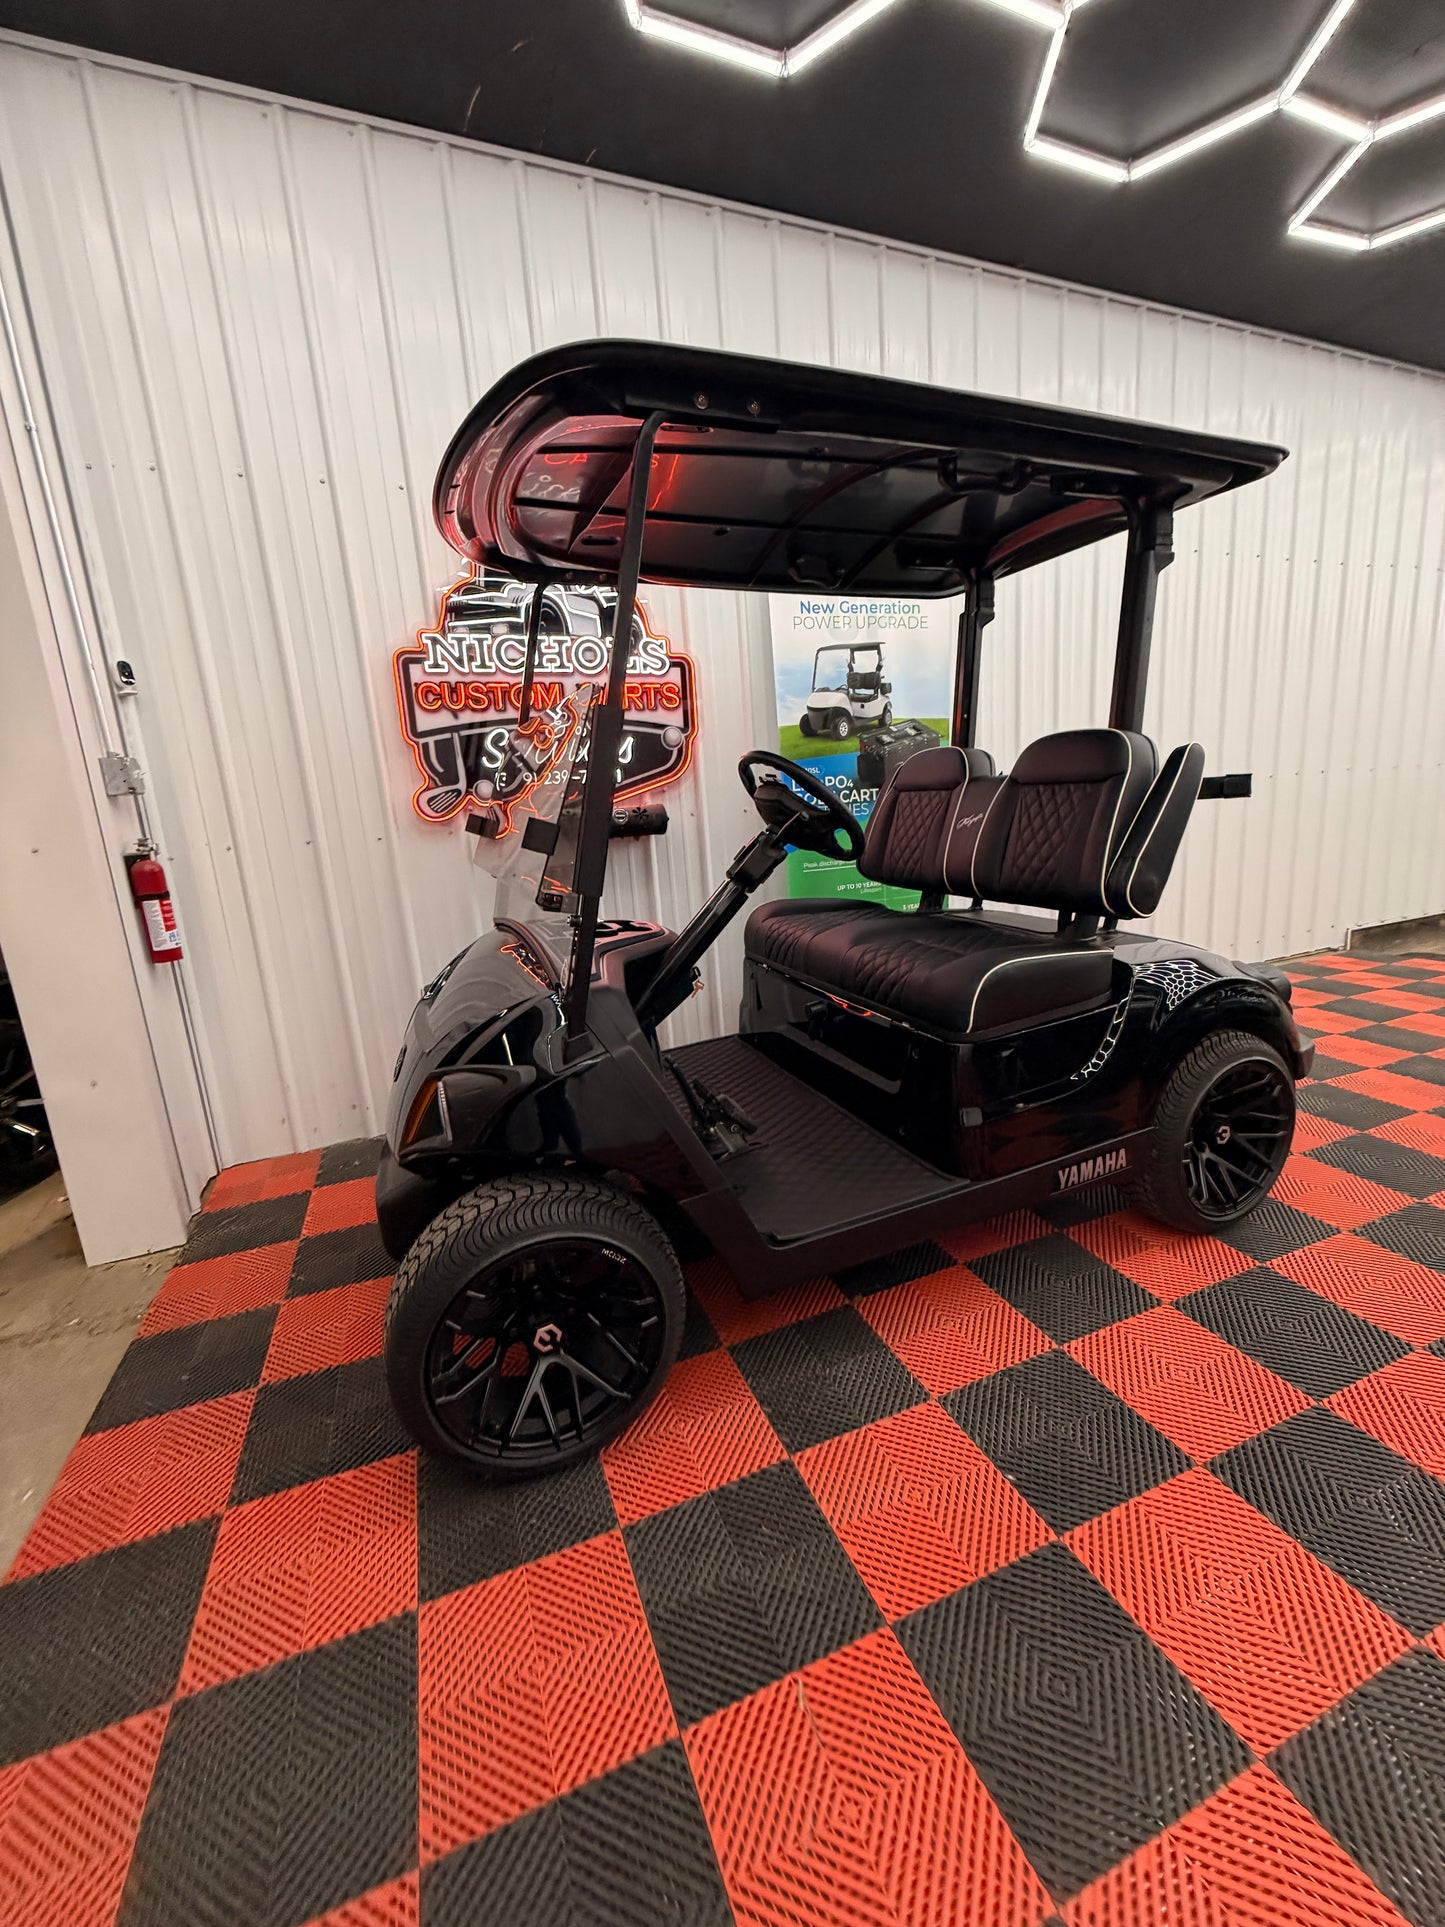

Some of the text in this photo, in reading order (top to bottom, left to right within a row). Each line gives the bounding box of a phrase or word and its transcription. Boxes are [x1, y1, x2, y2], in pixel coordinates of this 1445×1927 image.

[800, 600, 921, 614] New Generation
[793, 615, 929, 630] POWER UPGRADE
[416, 682, 564, 711] CUSTOM
[792, 775, 854, 792] LPO4
[840, 788, 879, 803] CART
[1058, 1148, 1127, 1190] YAMAHA
